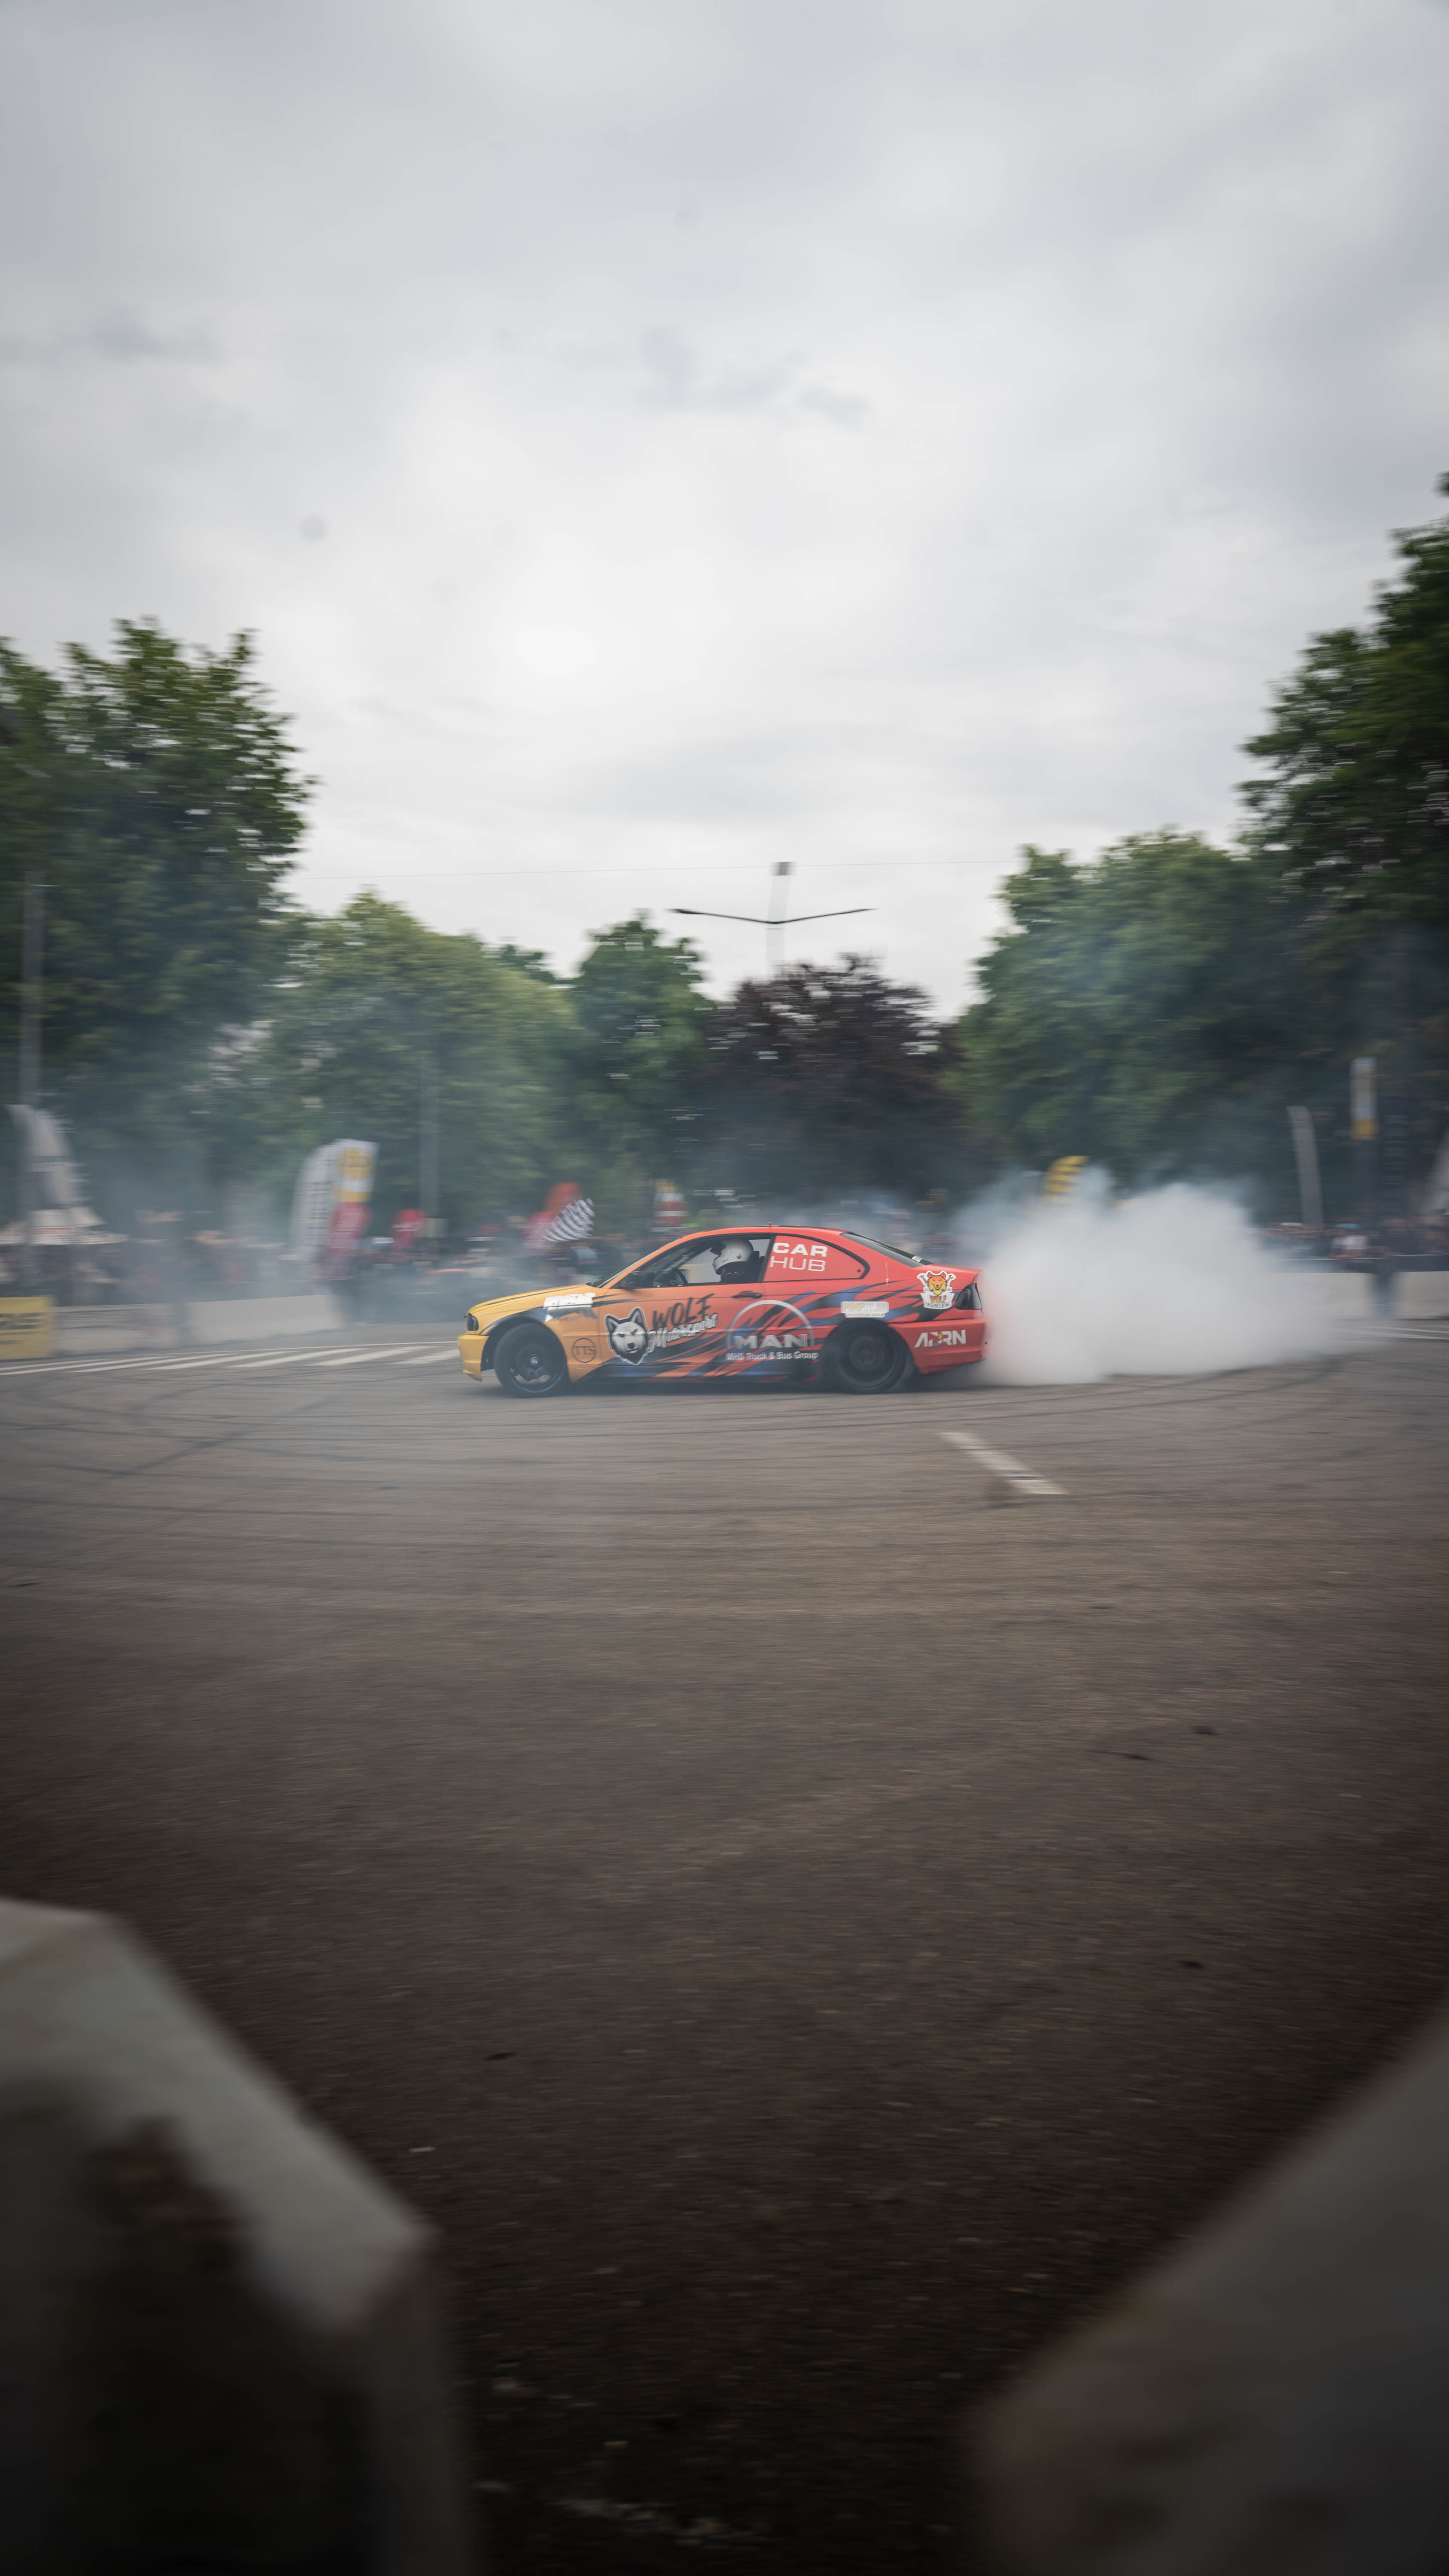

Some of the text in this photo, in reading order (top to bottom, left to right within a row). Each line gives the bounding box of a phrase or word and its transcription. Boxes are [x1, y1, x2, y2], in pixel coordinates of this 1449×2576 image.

[773, 1242, 828, 1257] CAR
[770, 1256, 825, 1272] HUB
[653, 1293, 715, 1330] WOLF
[733, 1334, 808, 1349] MAN
[793, 1351, 818, 1360] Group
